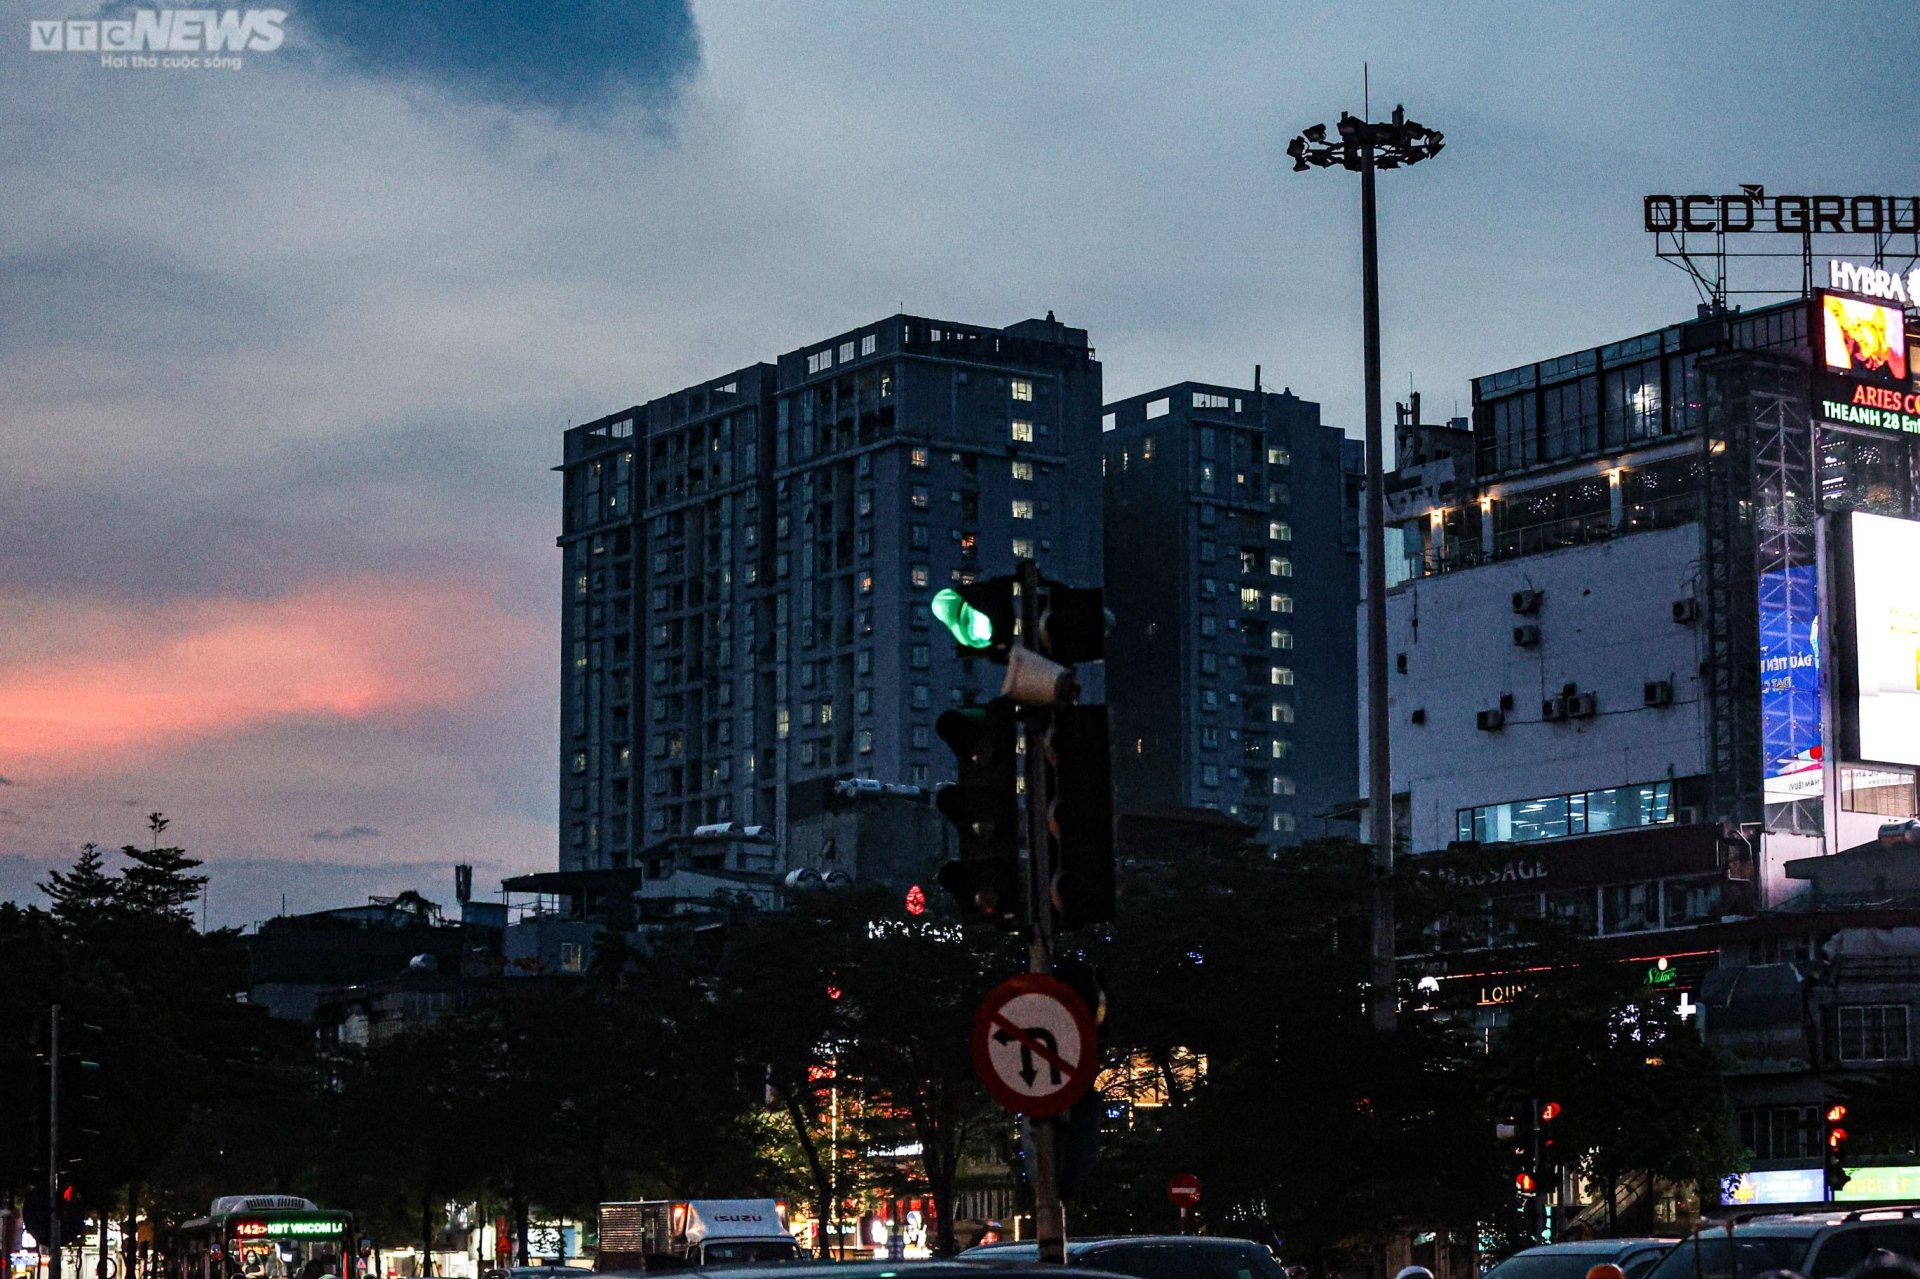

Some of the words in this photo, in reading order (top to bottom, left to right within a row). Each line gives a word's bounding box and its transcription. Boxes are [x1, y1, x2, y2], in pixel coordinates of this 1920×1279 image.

[1852, 384, 1902, 411] ARIES
[1822, 400, 1881, 427] THEANH
[1883, 411, 1901, 430] 28
[237, 1224, 258, 1234] 142
[290, 1223, 331, 1233] VINCOM
